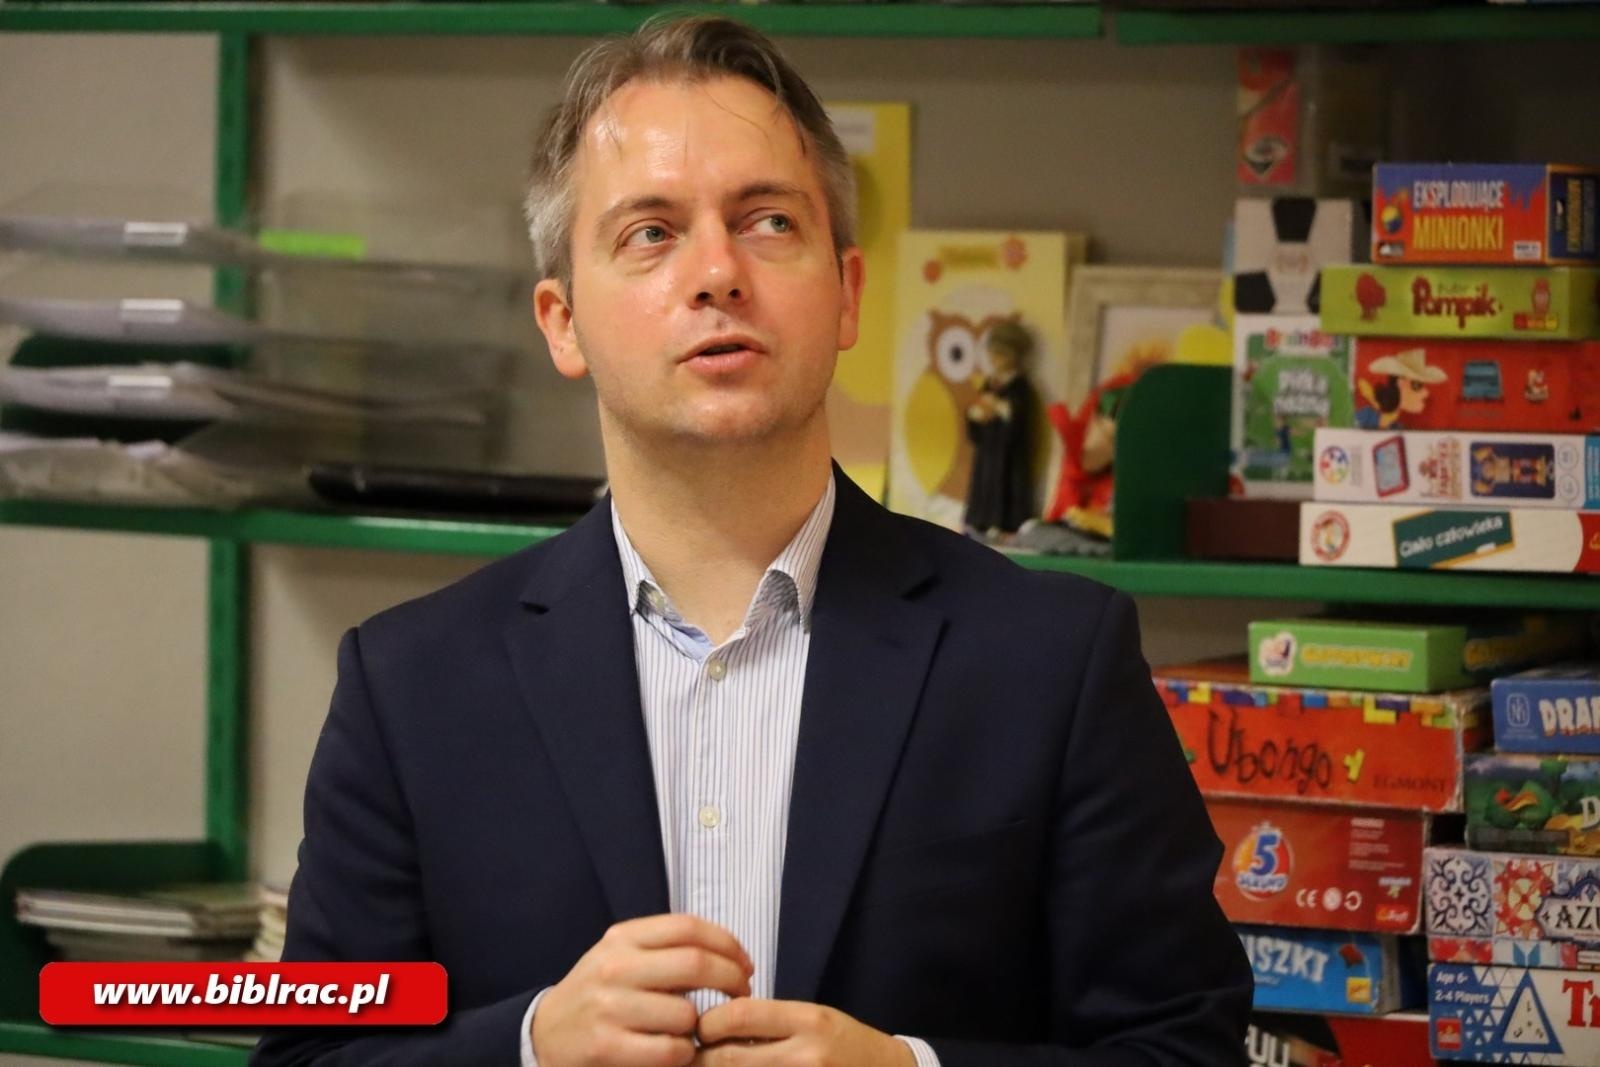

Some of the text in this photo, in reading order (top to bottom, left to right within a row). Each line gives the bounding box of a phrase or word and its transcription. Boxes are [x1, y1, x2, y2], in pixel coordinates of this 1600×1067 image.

[1412, 180, 1504, 211] EKSPLODUJĄCE
[1412, 215, 1504, 250] MINIONKI
[1207, 706, 1333, 794] Ubongo
[1373, 775, 1447, 793] EGMONT
[1250, 832, 1279, 876] 5
[1435, 989, 1490, 1005] 2-4 Players
